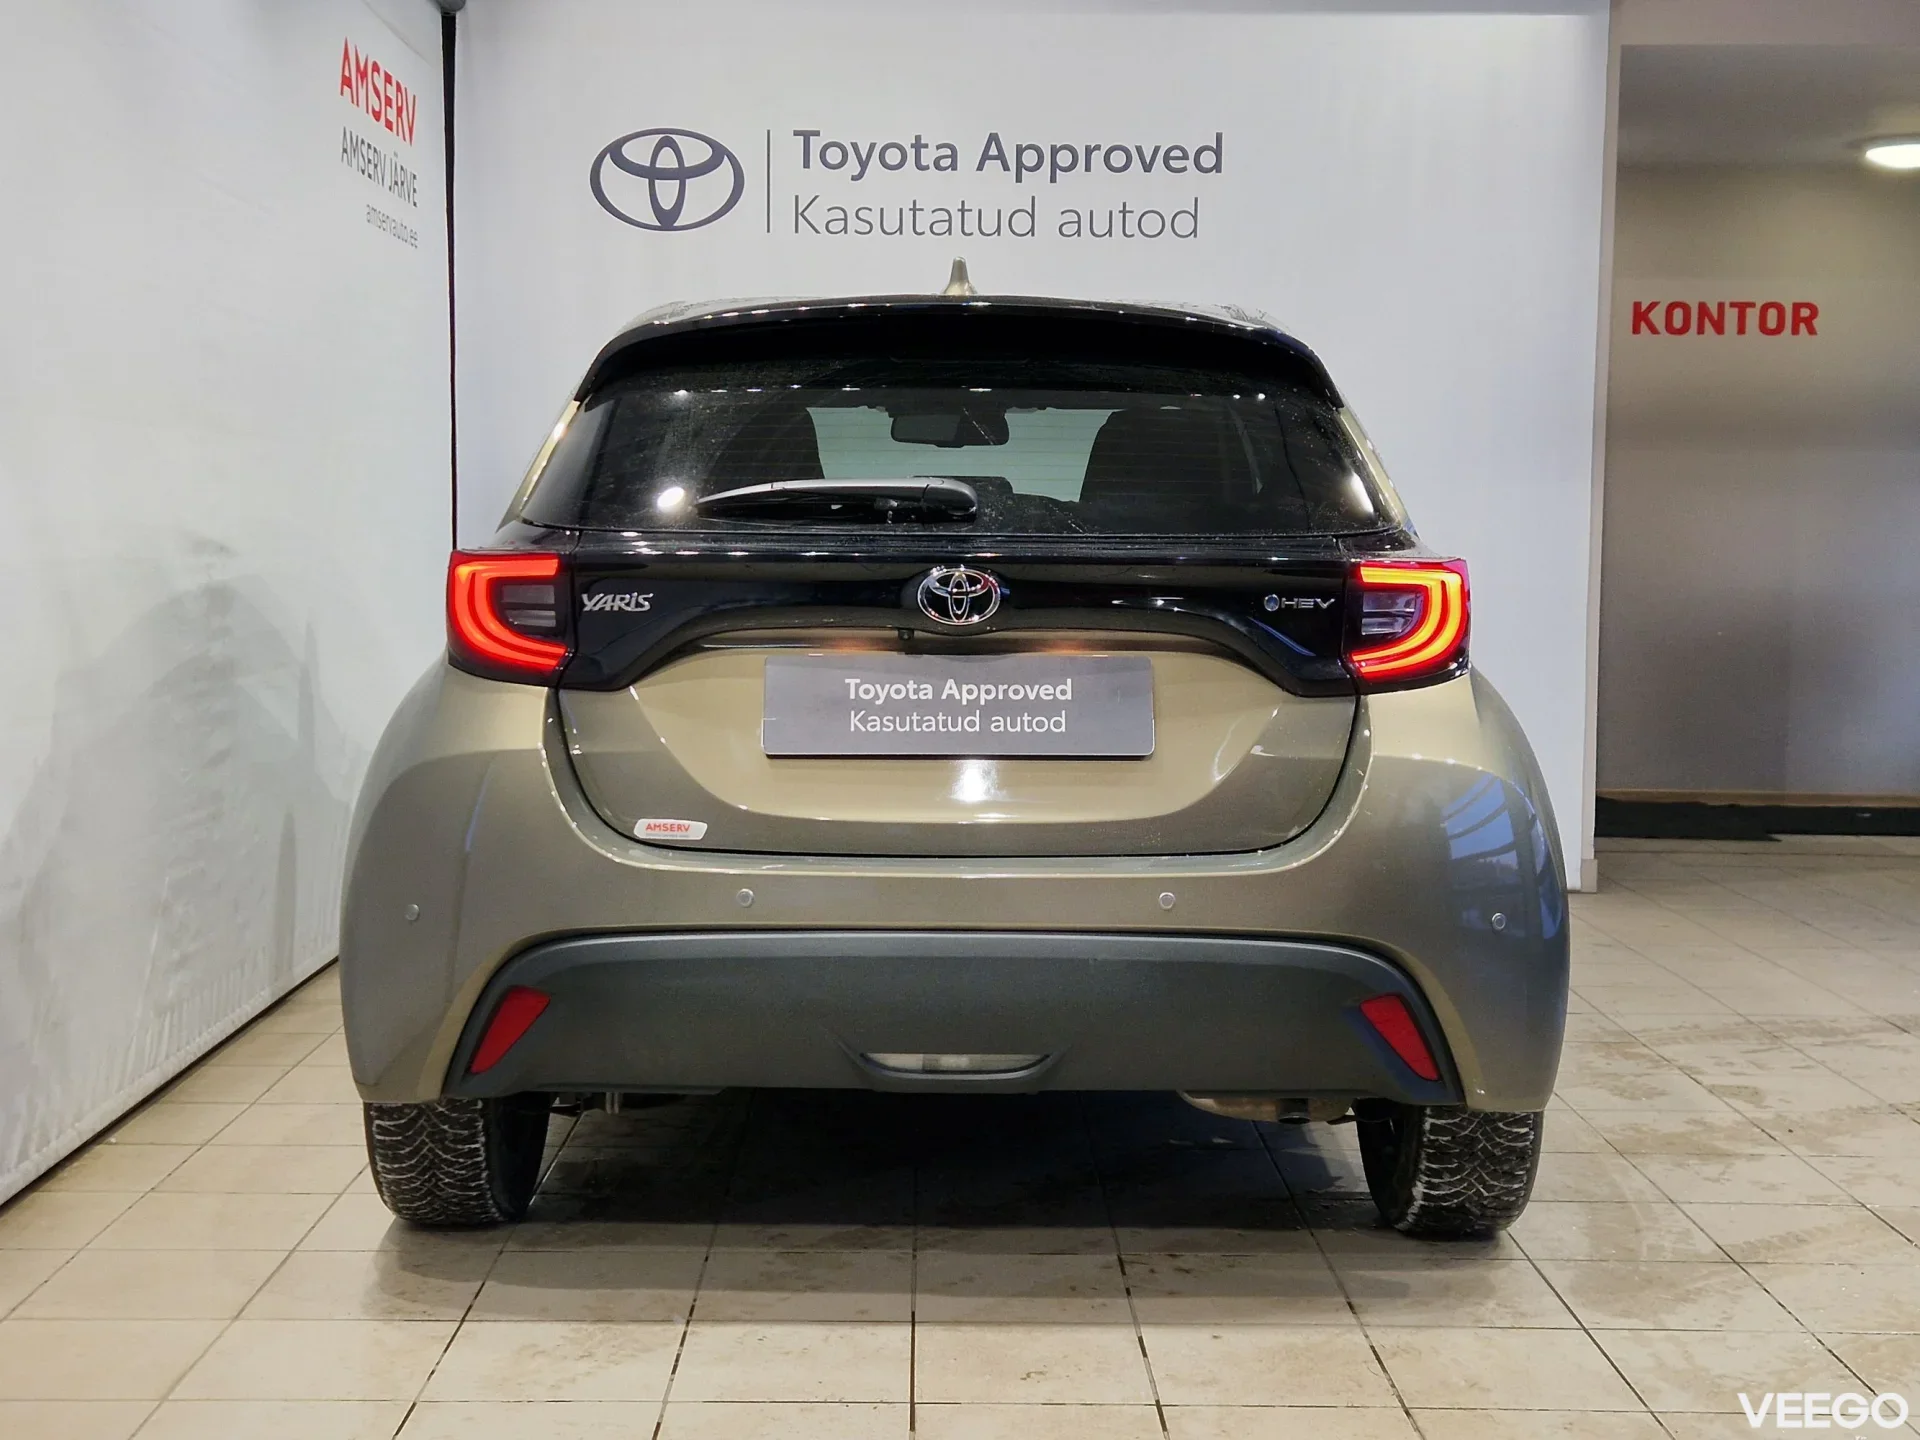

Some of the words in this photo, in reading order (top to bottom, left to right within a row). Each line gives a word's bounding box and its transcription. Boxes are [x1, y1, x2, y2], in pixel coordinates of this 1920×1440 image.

[340, 36, 416, 147] AMSERV
[341, 126, 387, 188] AMSERV
[388, 151, 418, 208] JÄRVE
[793, 129, 958, 180] Toyota
[976, 131, 1223, 184] Approved
[794, 194, 1037, 238] Kasutatud
[1058, 196, 1200, 239] autod
[1631, 300, 1820, 337] KONTOR
[1281, 597, 1336, 609] HEV
[845, 678, 933, 704] Toyota
[942, 678, 1072, 706] Approved
[850, 710, 980, 733] Kasutatud
[990, 710, 1067, 733] autod
[645, 823, 691, 832] AMSERV
